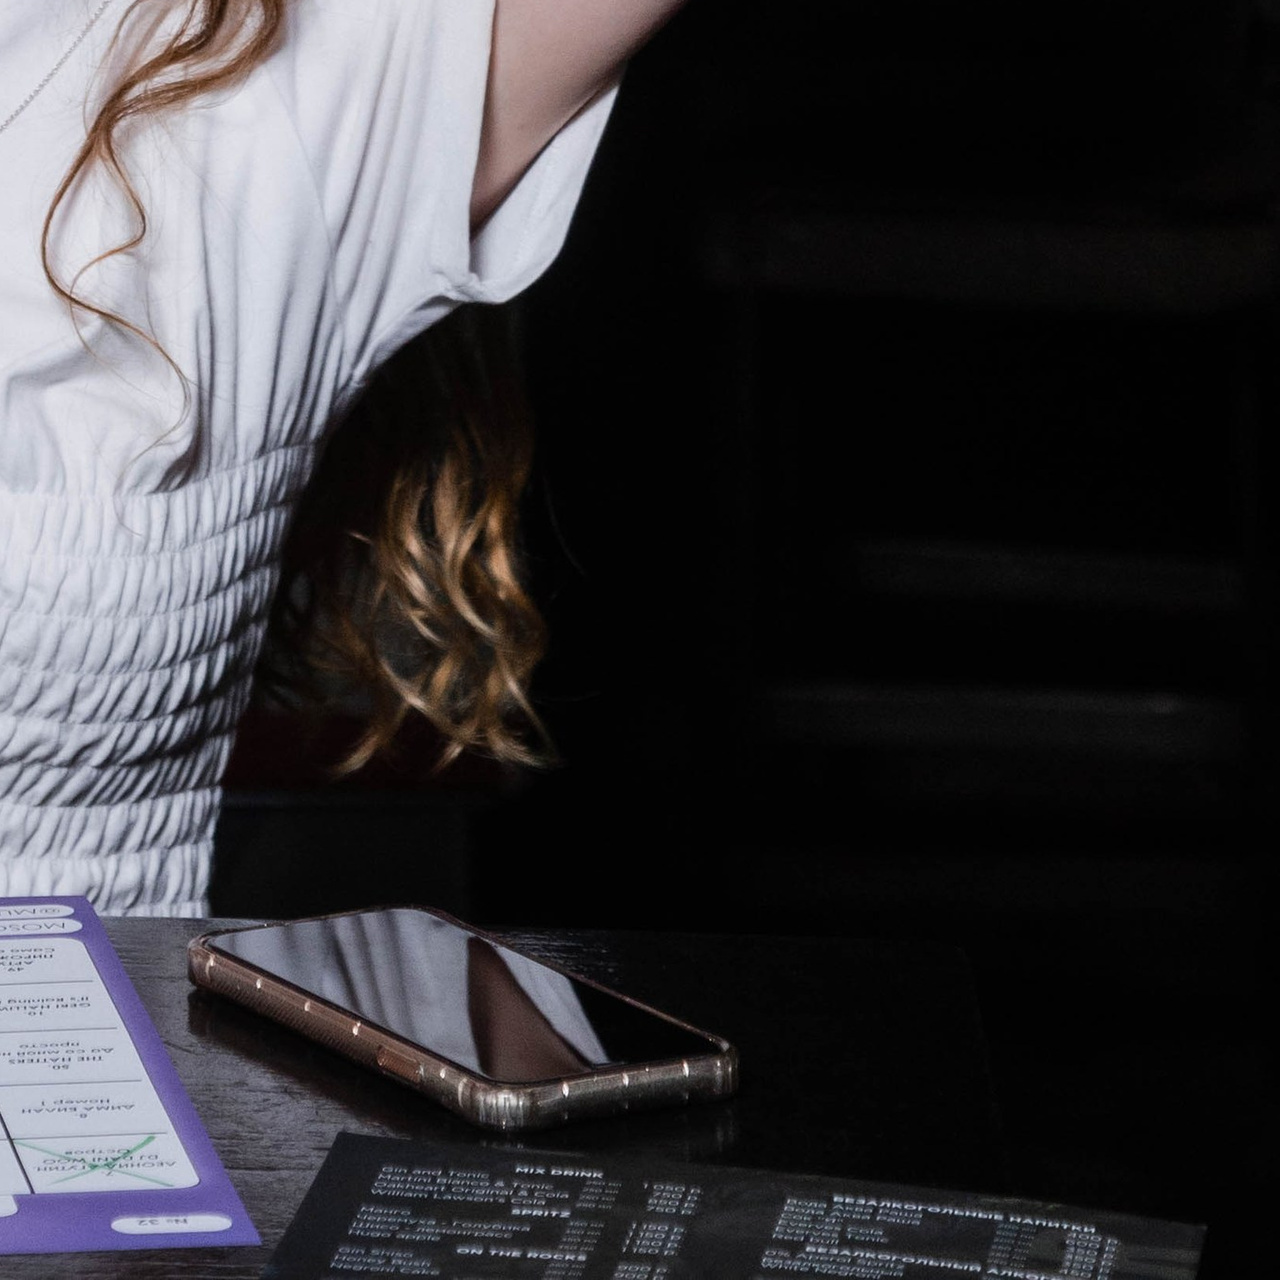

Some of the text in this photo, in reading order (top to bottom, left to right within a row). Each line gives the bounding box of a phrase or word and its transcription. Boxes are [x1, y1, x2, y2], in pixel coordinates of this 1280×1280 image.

[516, 1165, 603, 1178] MIX DRINK
[511, 1209, 571, 1218] SPRITZ
[527, 1253, 587, 1261] ROCKS
